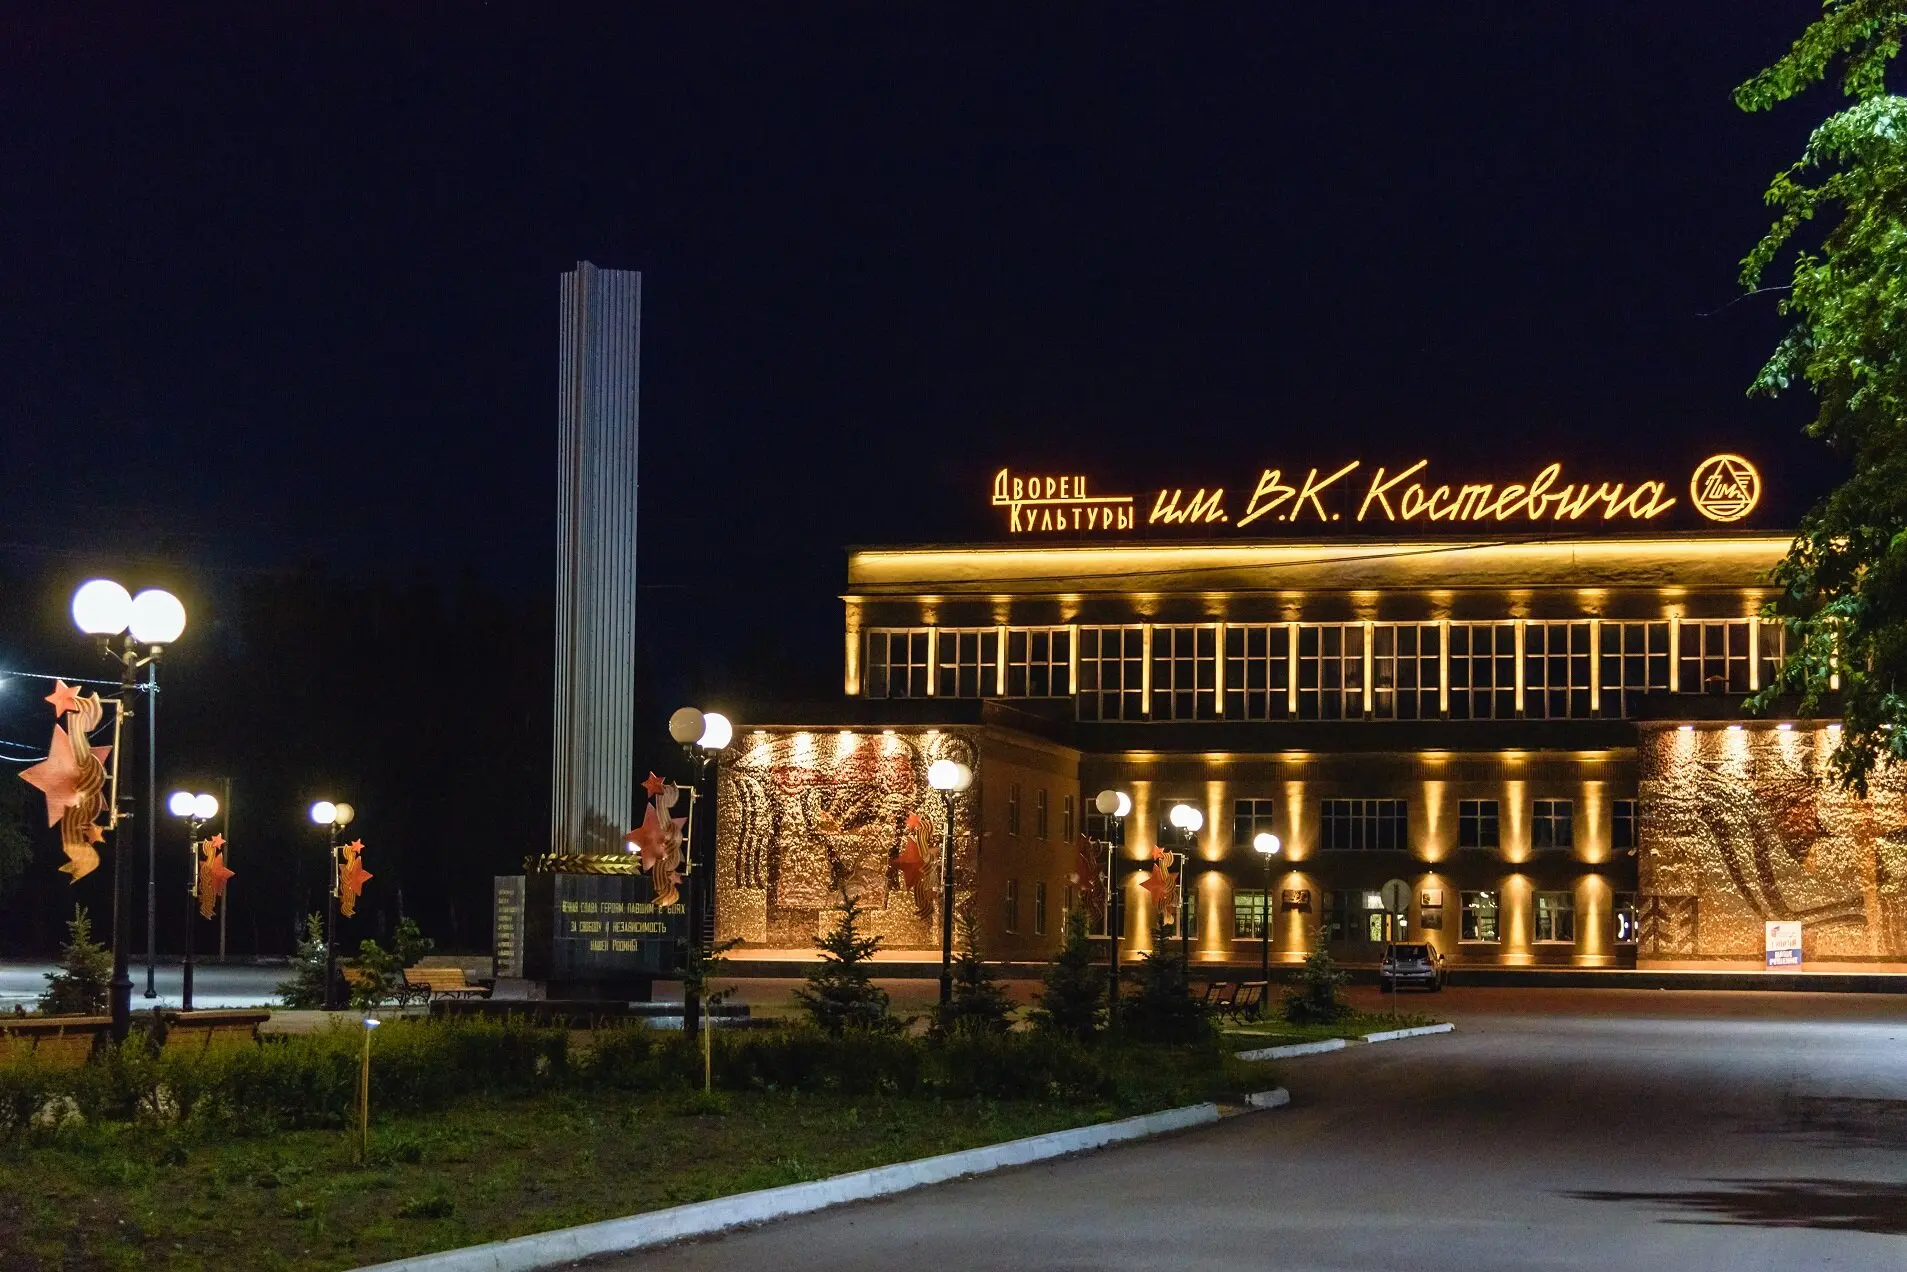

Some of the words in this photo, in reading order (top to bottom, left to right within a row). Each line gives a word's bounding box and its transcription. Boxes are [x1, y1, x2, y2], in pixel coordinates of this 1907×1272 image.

[992, 468, 1086, 505] ДВОРЕЦ
[1149, 488, 1228, 524] им.
[1237, 460, 1360, 527] В.К.
[1356, 459, 1677, 521] Костевича
[1010, 502, 1134, 532] КУЛЬТУРЫ
